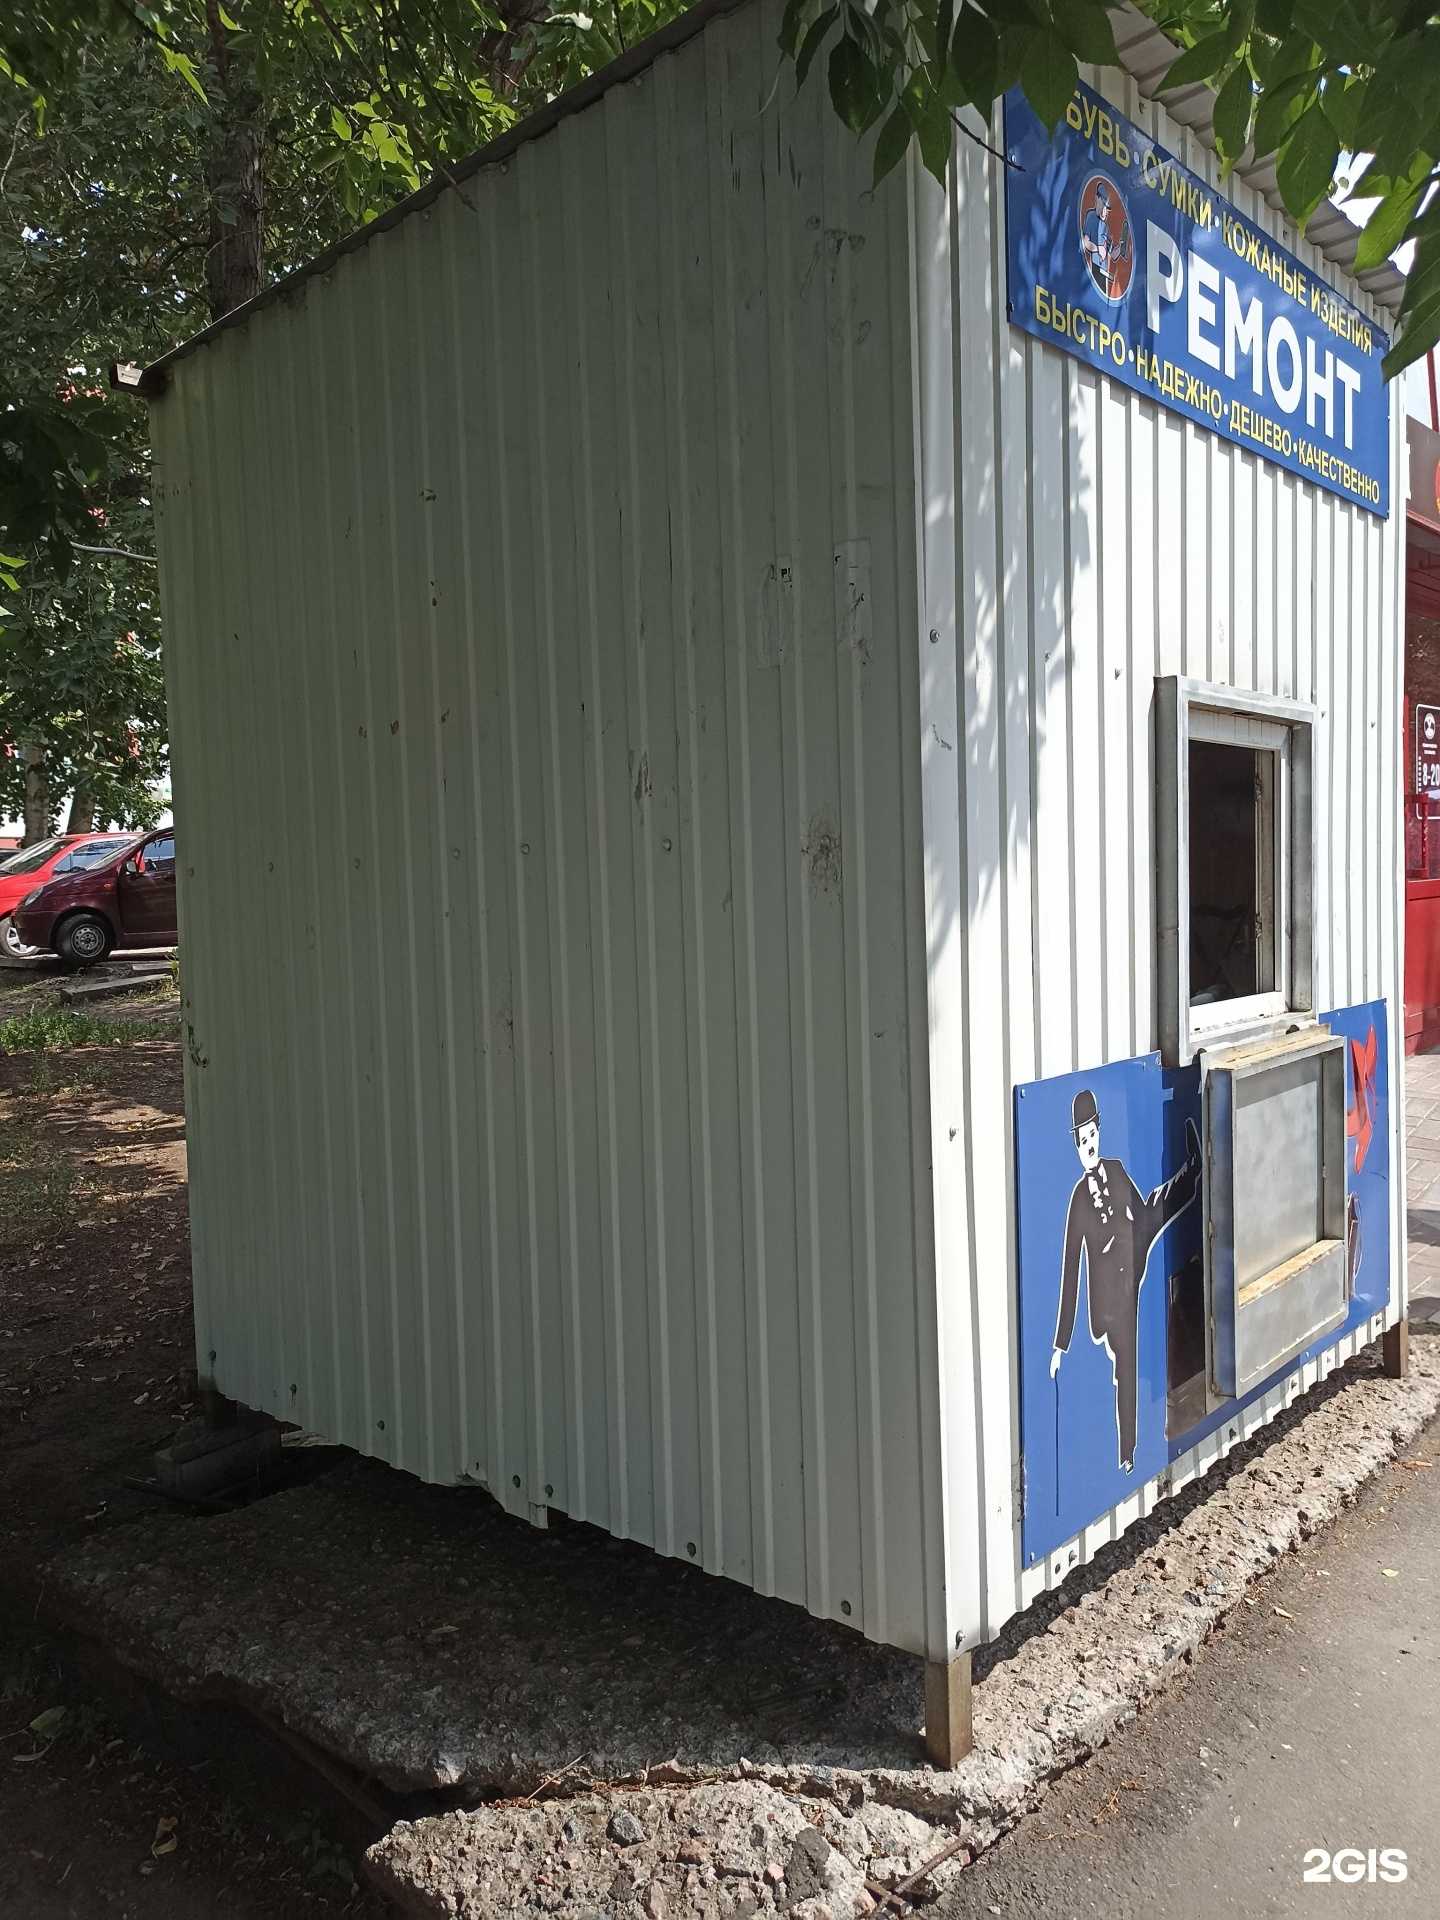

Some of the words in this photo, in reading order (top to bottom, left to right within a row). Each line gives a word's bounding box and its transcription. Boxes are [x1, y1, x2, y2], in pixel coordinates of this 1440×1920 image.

[1066, 90, 1131, 168] БУВЬ
[1142, 150, 1212, 232] СУМКИ
[1222, 211, 1307, 307] КОЖАНЫЕ
[1311, 283, 1372, 357] ИЗДЕЛИЯ
[1146, 219, 1361, 450] РЕМОНТ
[1035, 284, 1126, 366] БЫСТРО
[1136, 345, 1222, 420] НАДЕЖНО
[1229, 400, 1292, 457] ДЕШЕВО
[1299, 438, 1380, 504] КАЧЕСТВЕННО
